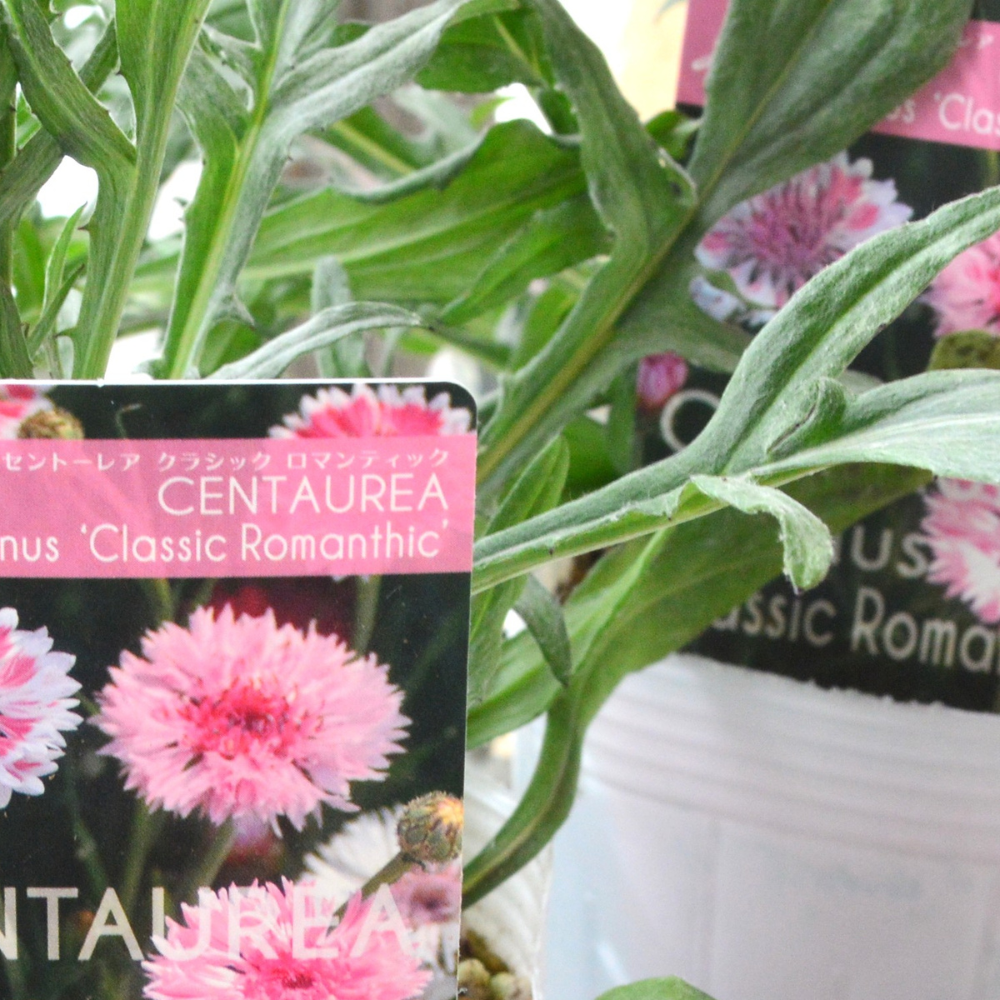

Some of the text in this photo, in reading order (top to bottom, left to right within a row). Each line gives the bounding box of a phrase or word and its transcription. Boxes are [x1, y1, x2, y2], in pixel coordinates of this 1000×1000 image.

[2, 448, 450, 474] セントーレア クラシック ロマンティック
[157, 471, 450, 518] CENTAUREA
[852, 586, 1000, 676] Roma
